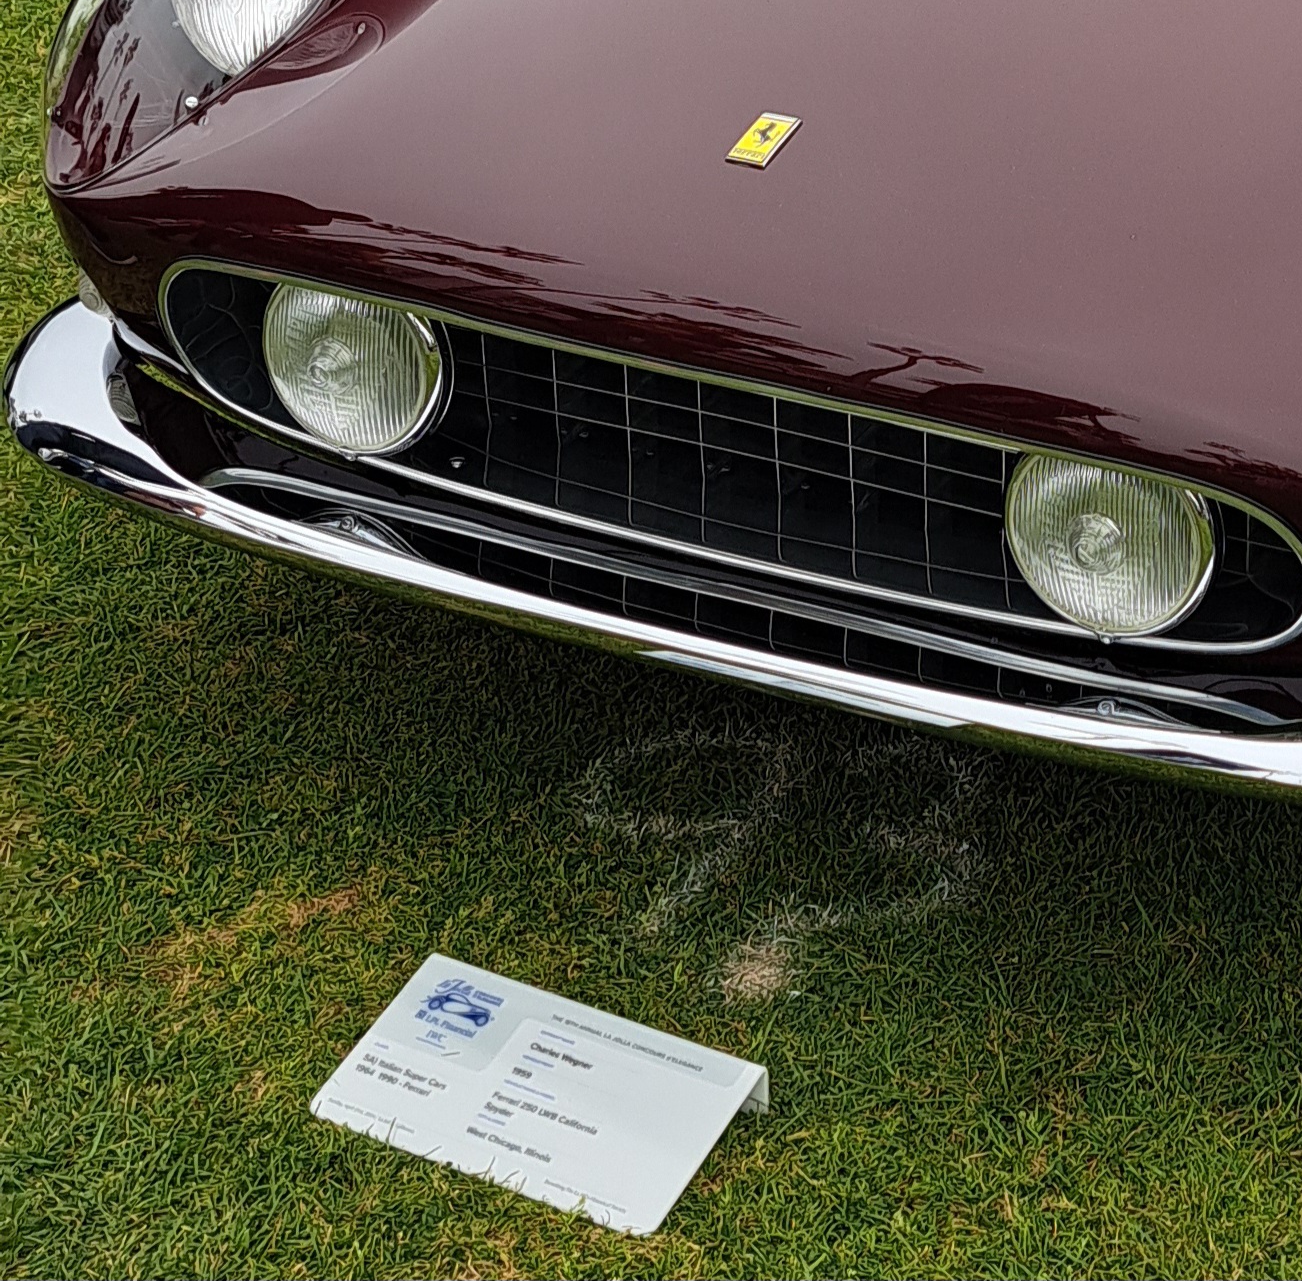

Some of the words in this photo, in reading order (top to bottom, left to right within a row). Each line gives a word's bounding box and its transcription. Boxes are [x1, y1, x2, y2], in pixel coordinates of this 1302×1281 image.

[732, 148, 766, 159] Ferrari
[603, 1032, 612, 1040] LA
[612, 1035, 631, 1047] JOLLA
[530, 1042, 561, 1059] Charles
[561, 1053, 594, 1070] Wegner
[378, 1059, 403, 1074] Italian
[403, 1068, 428, 1083] Super
[428, 1078, 447, 1090] Cars
[378, 1072, 399, 1085] 1990
[402, 1081, 432, 1097] Ferrari
[512, 1066, 533, 1079] 1959
[484, 1101, 514, 1118] Spyder
[491, 1091, 522, 1107] Ferrari
[520, 1101, 539, 1113] 250
[538, 1108, 559, 1120] LWB
[558, 1115, 598, 1135] California
[466, 1125, 488, 1140] West
[487, 1134, 522, 1154] Chicago,
[523, 1147, 552, 1163] Illinois
